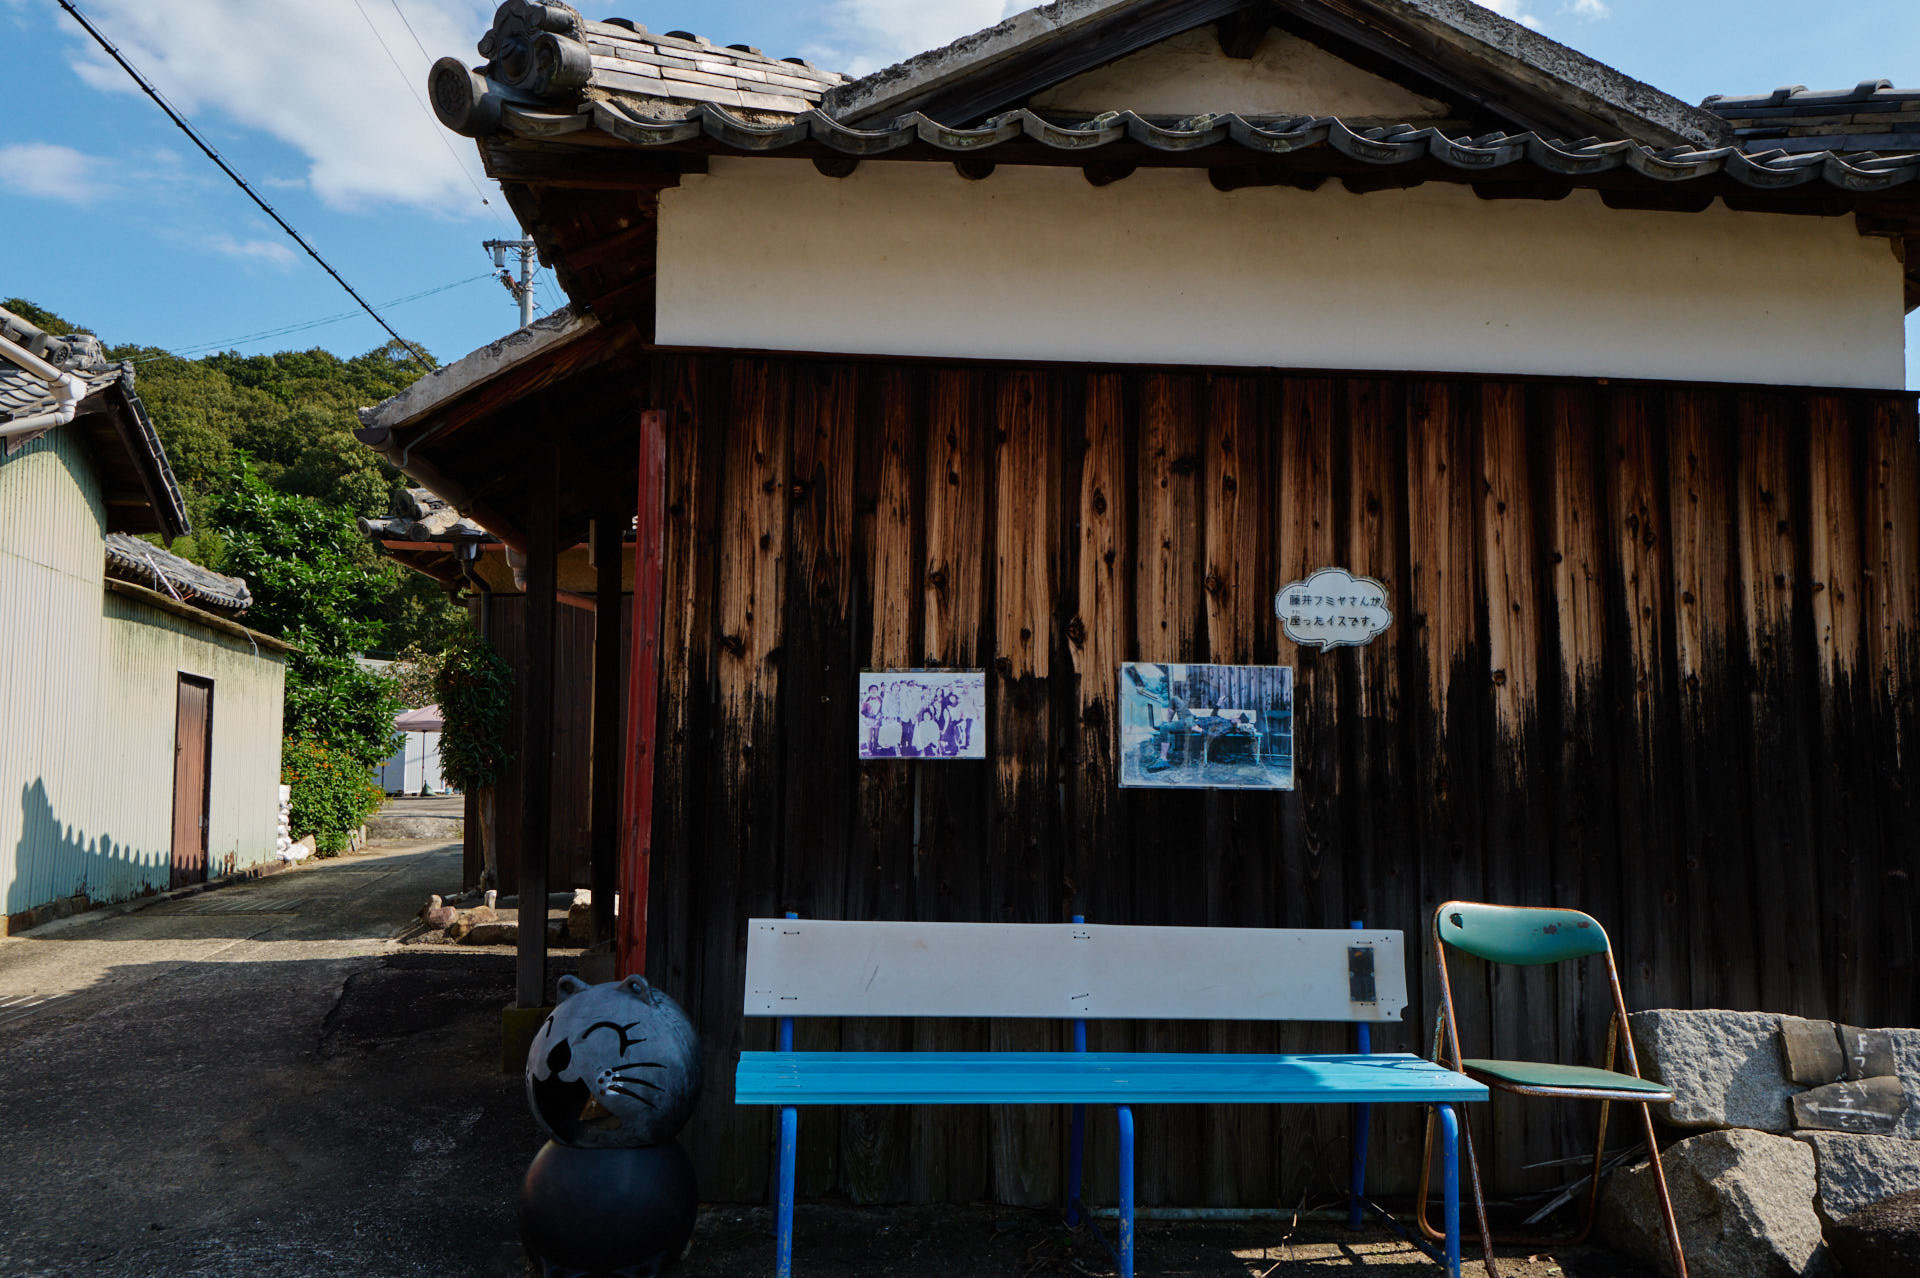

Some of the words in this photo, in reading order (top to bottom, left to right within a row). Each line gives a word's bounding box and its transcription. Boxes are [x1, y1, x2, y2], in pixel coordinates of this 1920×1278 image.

[1289, 615, 1376, 627] 座ったイスです。
